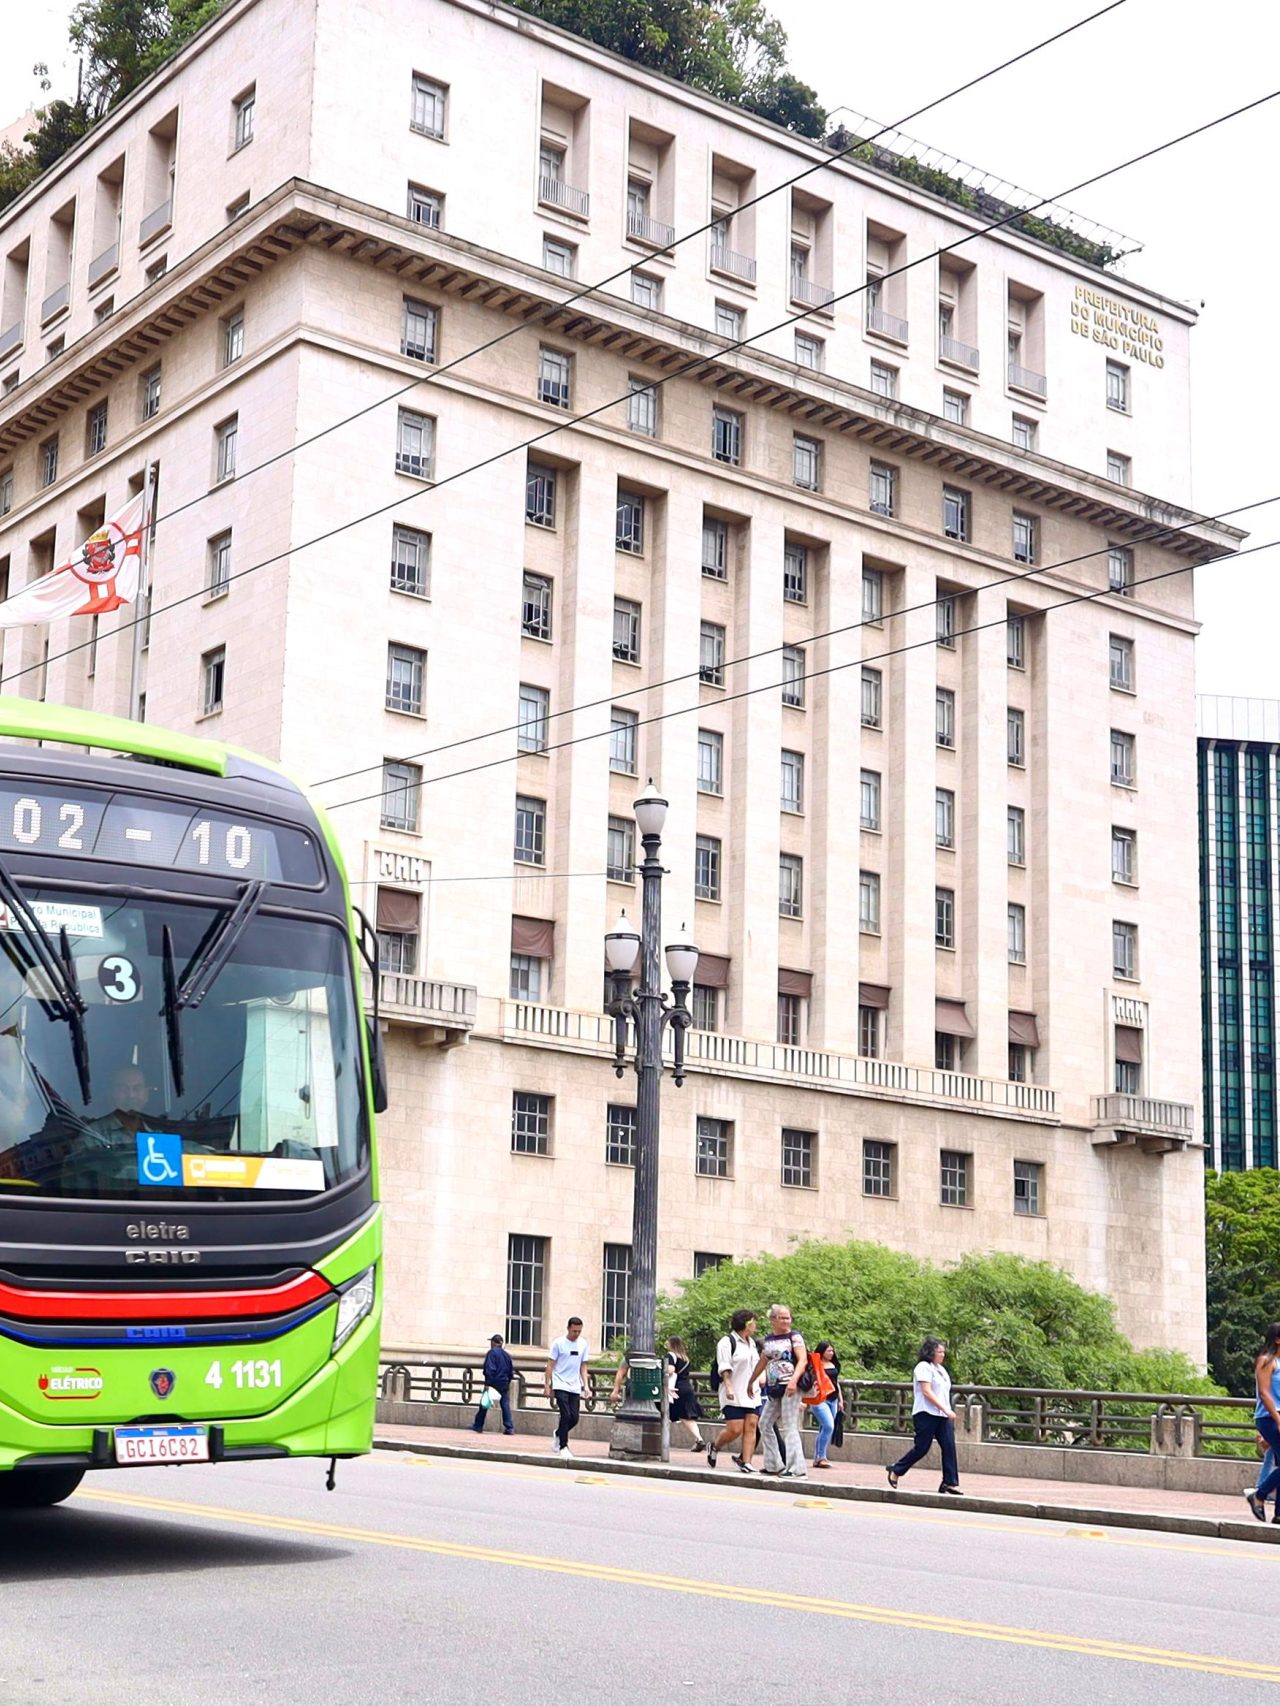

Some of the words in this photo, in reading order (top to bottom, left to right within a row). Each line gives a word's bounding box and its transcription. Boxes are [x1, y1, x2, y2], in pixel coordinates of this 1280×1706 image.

[1071, 301, 1089, 321] DO
[1094, 310, 1163, 352] MUNICÍPIO
[1075, 284, 1158, 334] PREFEITURA
[1071, 318, 1089, 338] DE
[1092, 329, 1118, 350] SÃO
[1123, 340, 1164, 369] PAULO
[192, 821, 251, 870] 10
[47, 904, 97, 919] Municipal
[103, 957, 137, 1000] 3
[126, 1221, 190, 1240] eletra
[50, 1375, 103, 1390] ELÉTRICO
[204, 1360, 223, 1389] 4
[230, 1360, 282, 1389] 1131
[126, 1437, 199, 1459] GCI6C82
